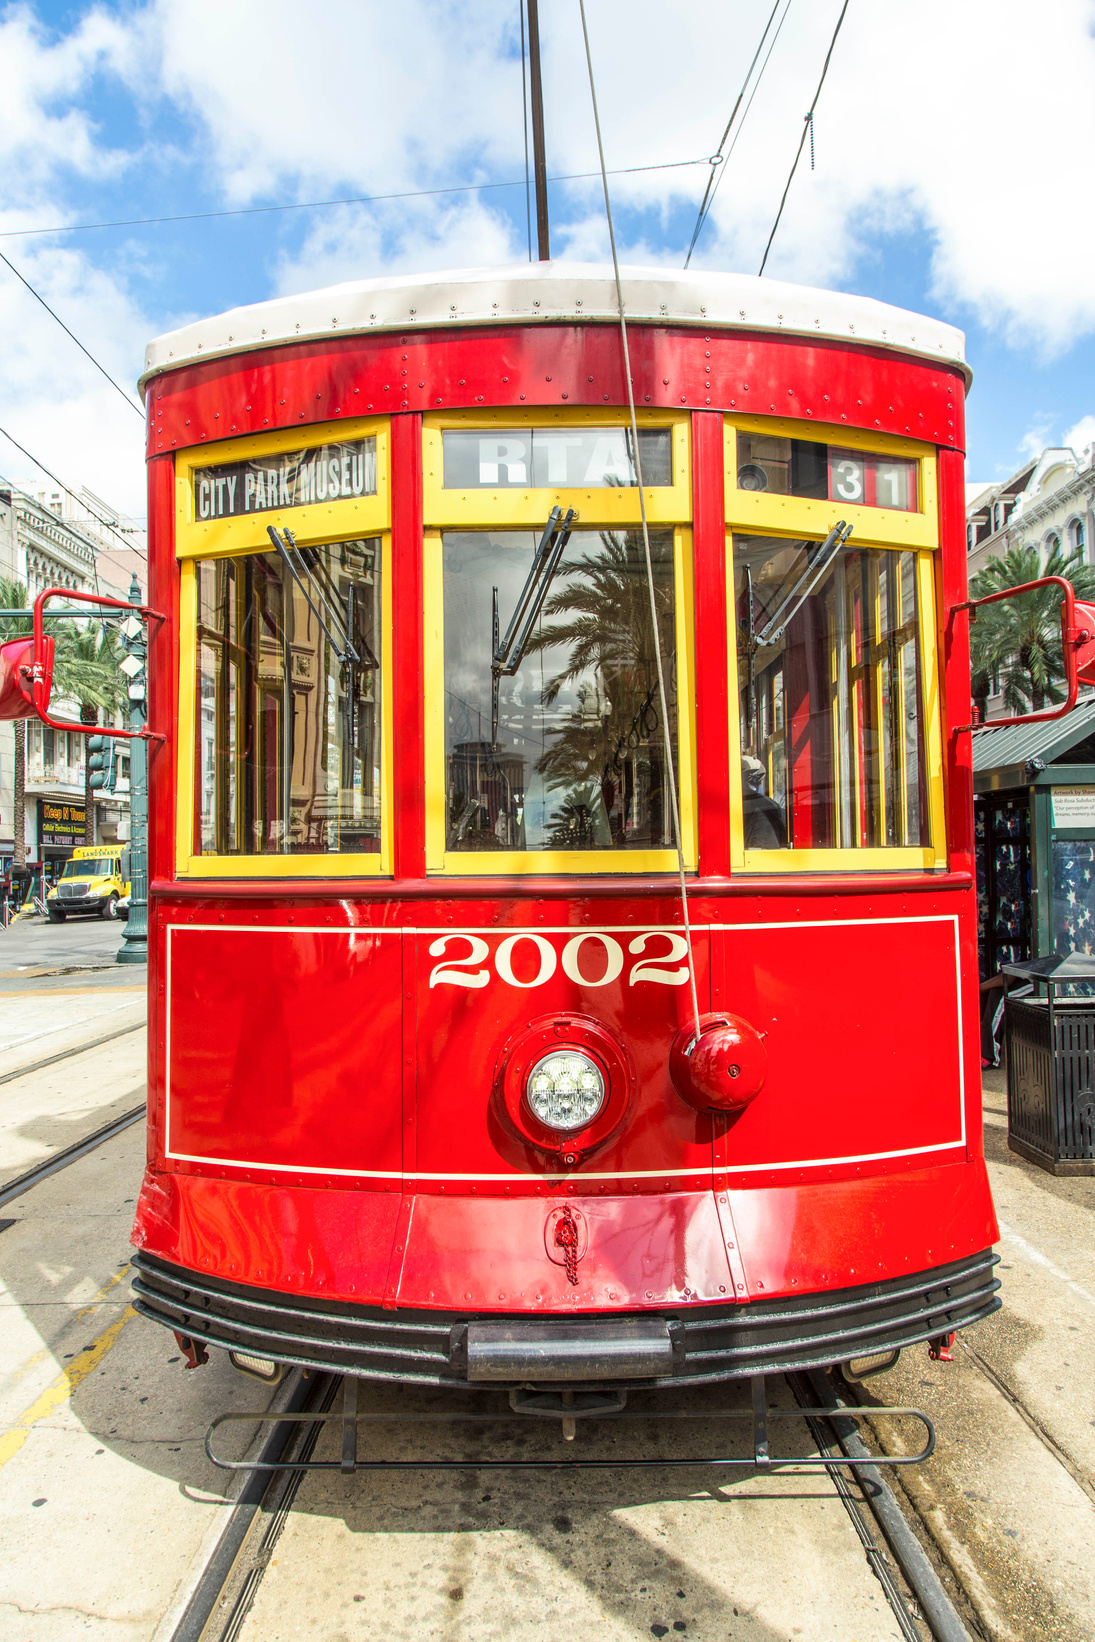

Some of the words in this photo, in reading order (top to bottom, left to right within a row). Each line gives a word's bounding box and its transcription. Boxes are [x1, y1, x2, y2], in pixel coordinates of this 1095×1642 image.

[479, 437, 637, 483] RTA
[199, 475, 237, 518] CITY
[42, 823, 54, 831] Cellular
[55, 824, 70, 833] Electronics
[43, 804, 62, 821] Keep
[62, 806, 69, 820] N
[70, 807, 86, 822] Touc
[42, 834, 53, 844] BILL
[429, 931, 690, 989] 2002
